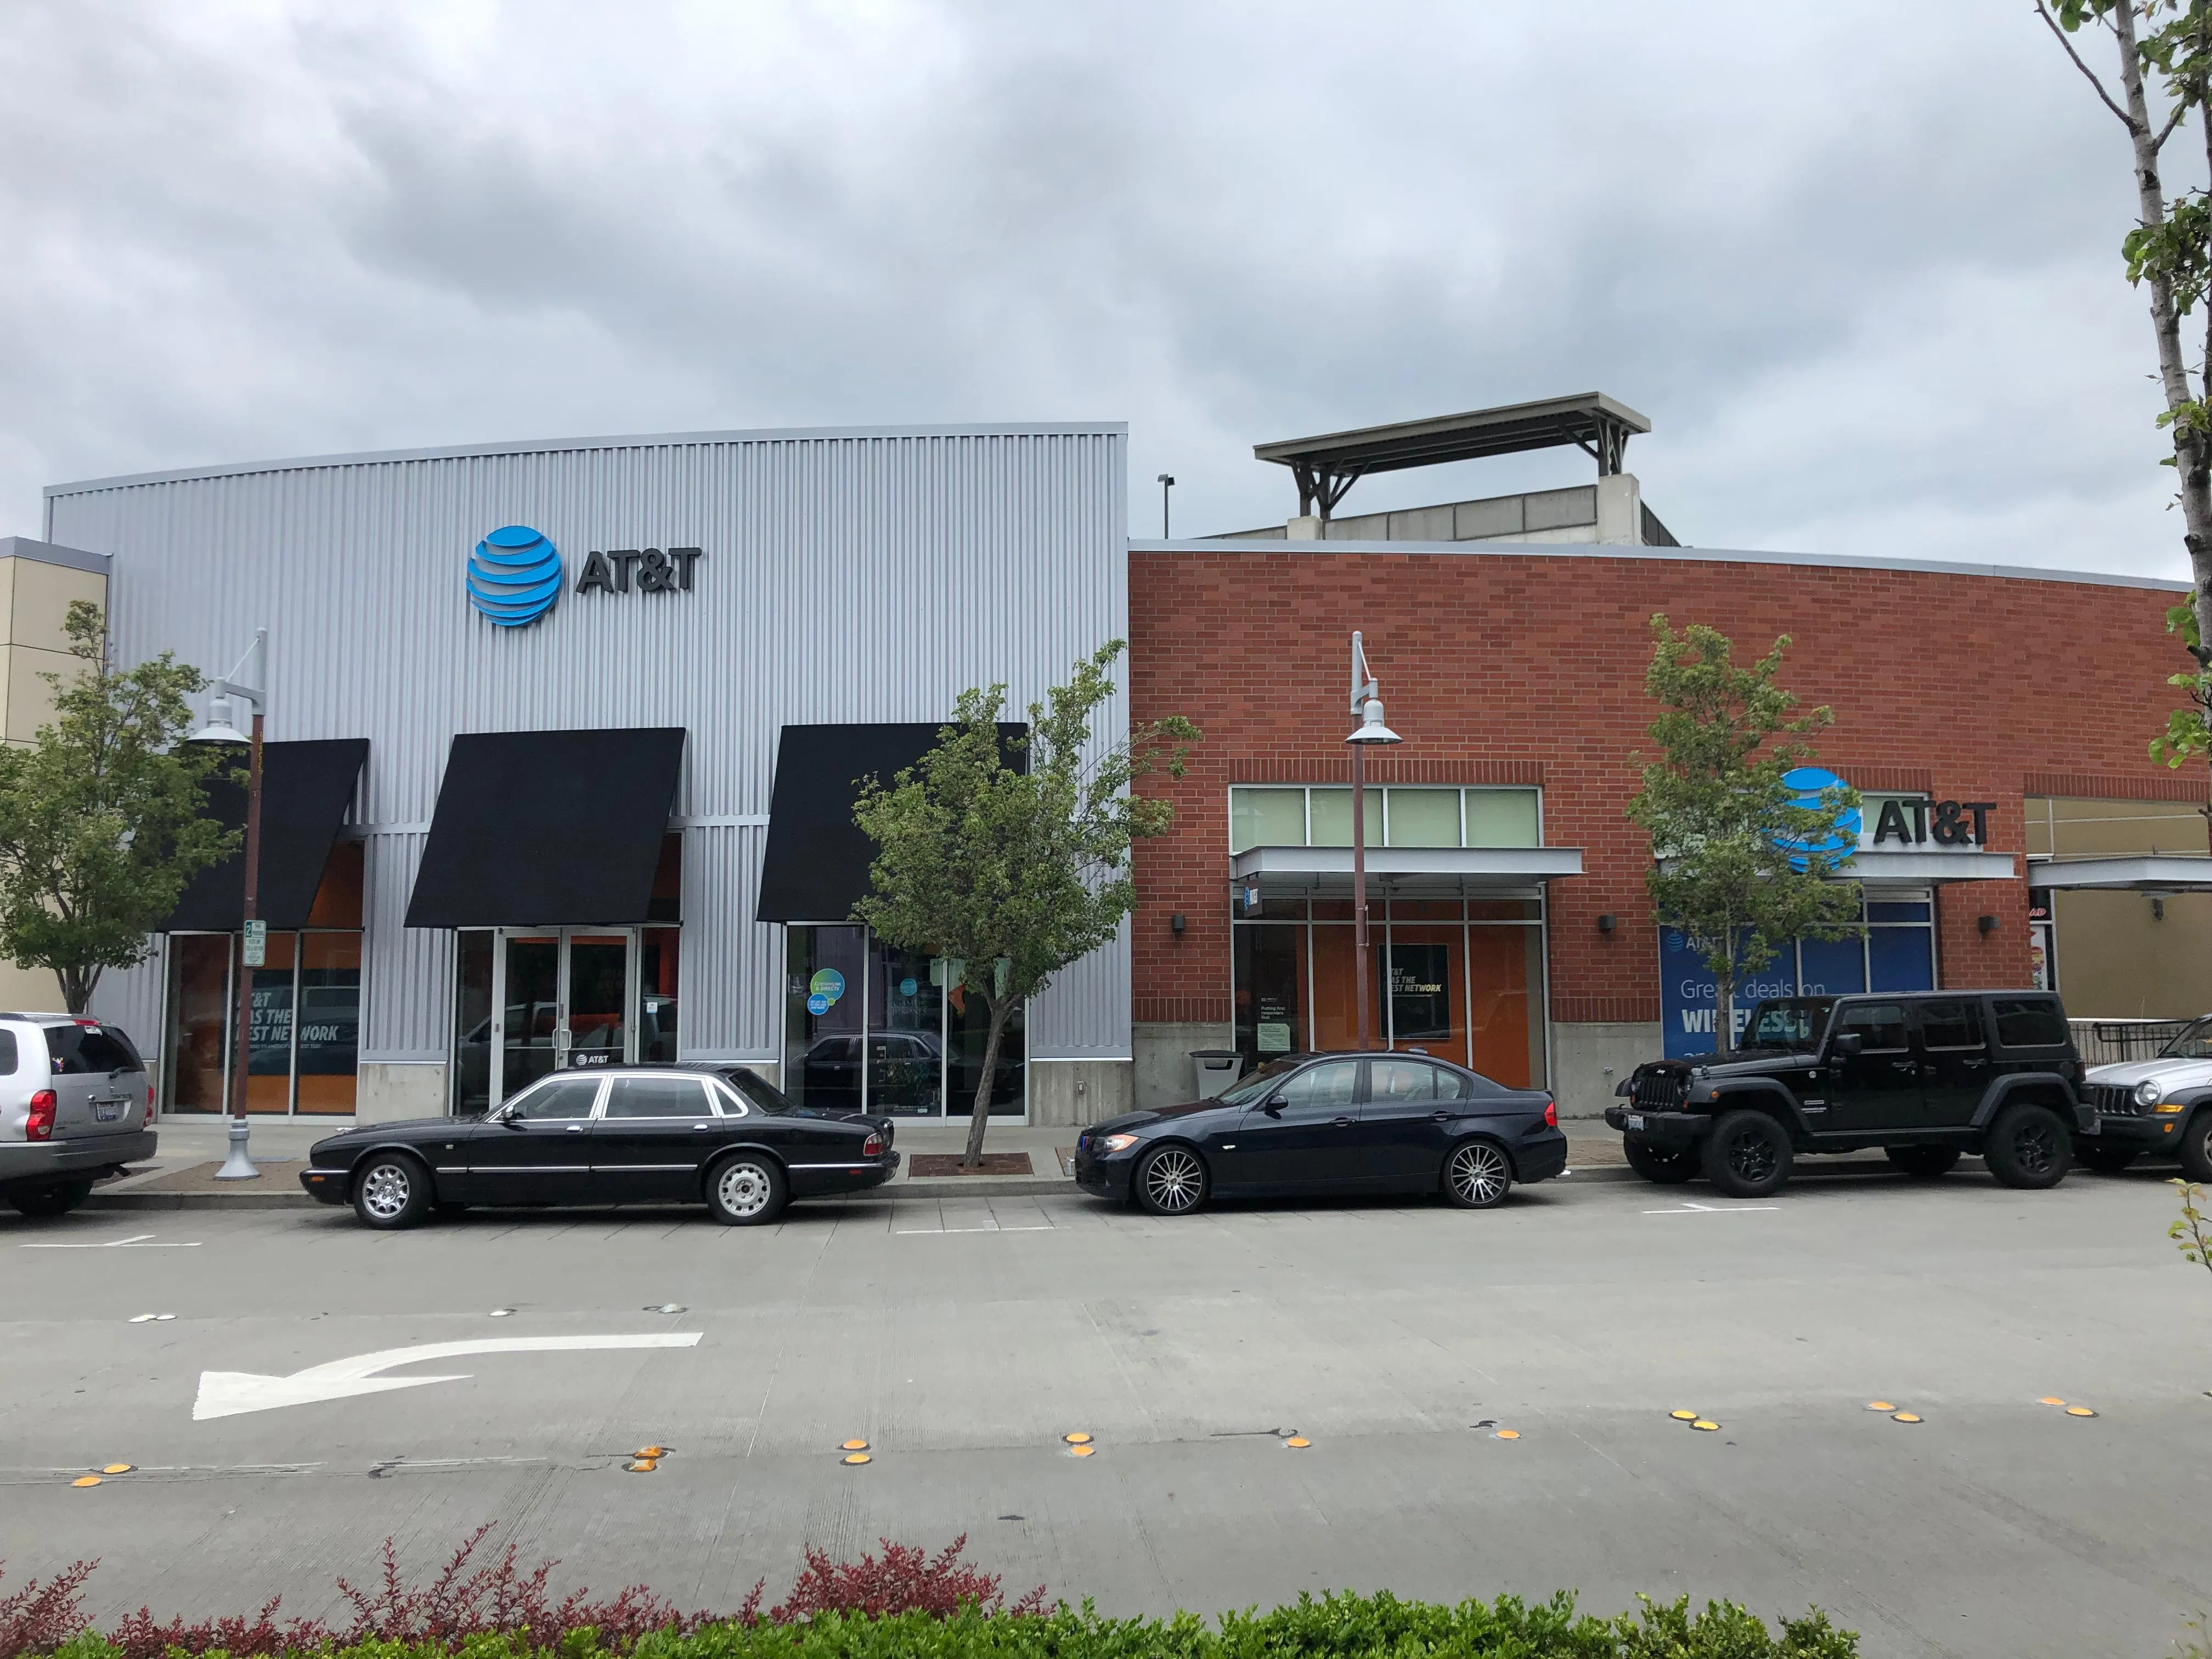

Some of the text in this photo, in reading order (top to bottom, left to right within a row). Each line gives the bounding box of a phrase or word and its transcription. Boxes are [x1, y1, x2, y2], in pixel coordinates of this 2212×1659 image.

[575, 548, 702, 594] AT&T
[1874, 800, 1997, 844] AT&T
[1745, 979, 1793, 998] deals
[266, 1009, 294, 1024] THE
[236, 1025, 340, 1041] EST NEWORK
[588, 1055, 609, 1064] AT&T
